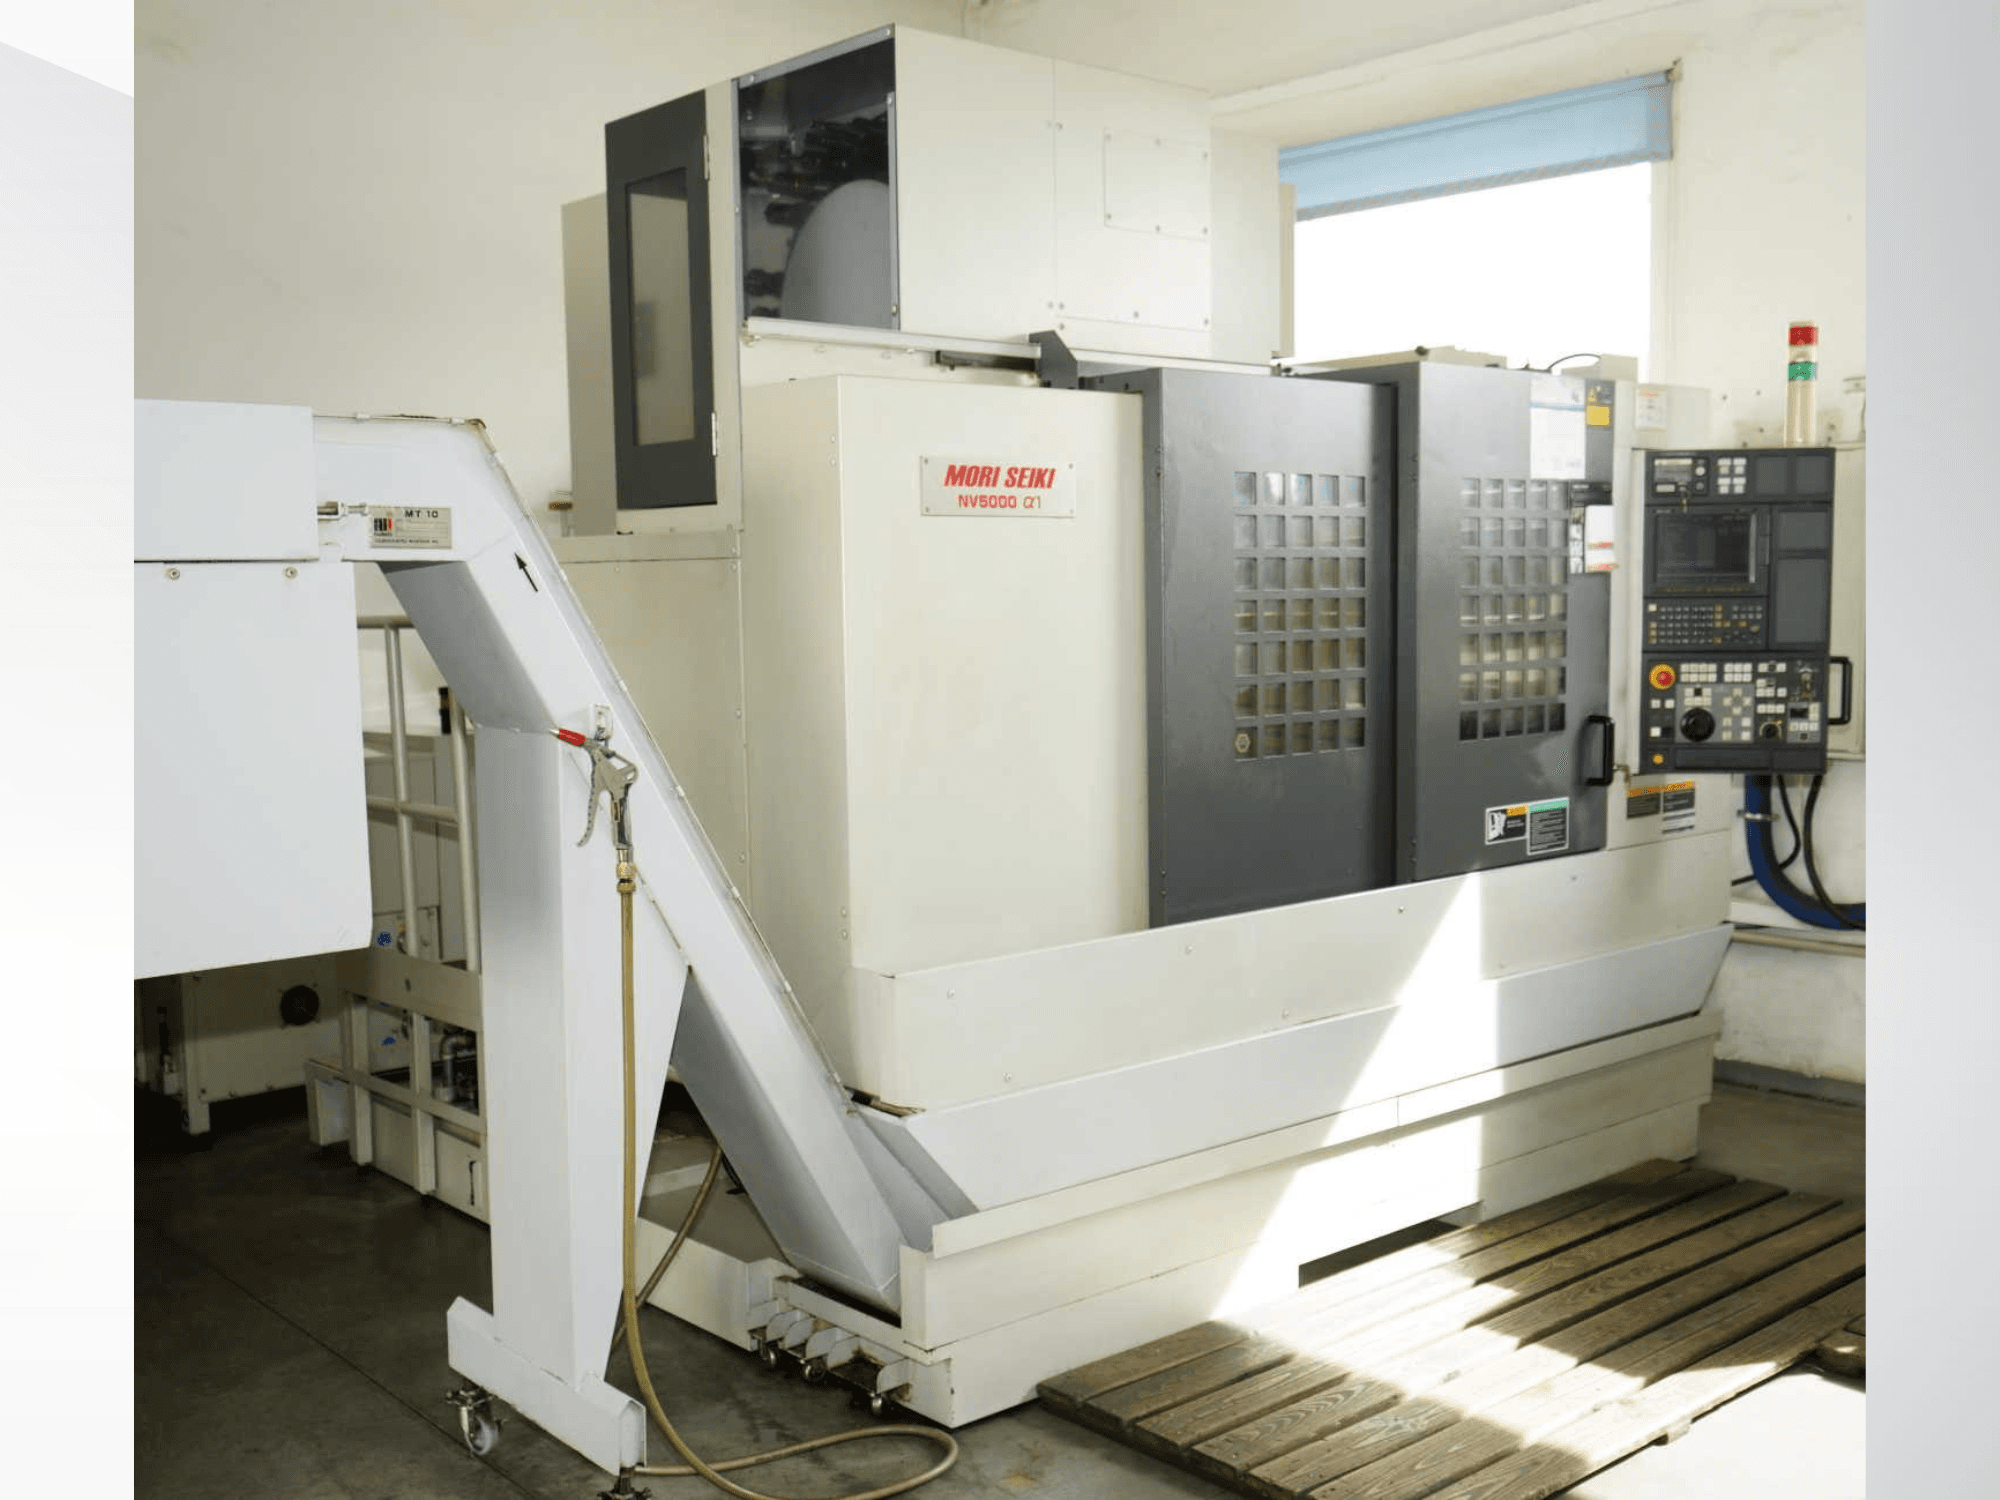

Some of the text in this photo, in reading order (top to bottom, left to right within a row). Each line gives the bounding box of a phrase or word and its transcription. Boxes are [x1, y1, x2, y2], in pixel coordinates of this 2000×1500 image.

[944, 464, 1056, 489] MORI SEIKI
[957, 494, 1018, 509] NV5000
[404, 509, 439, 518] MT 10
